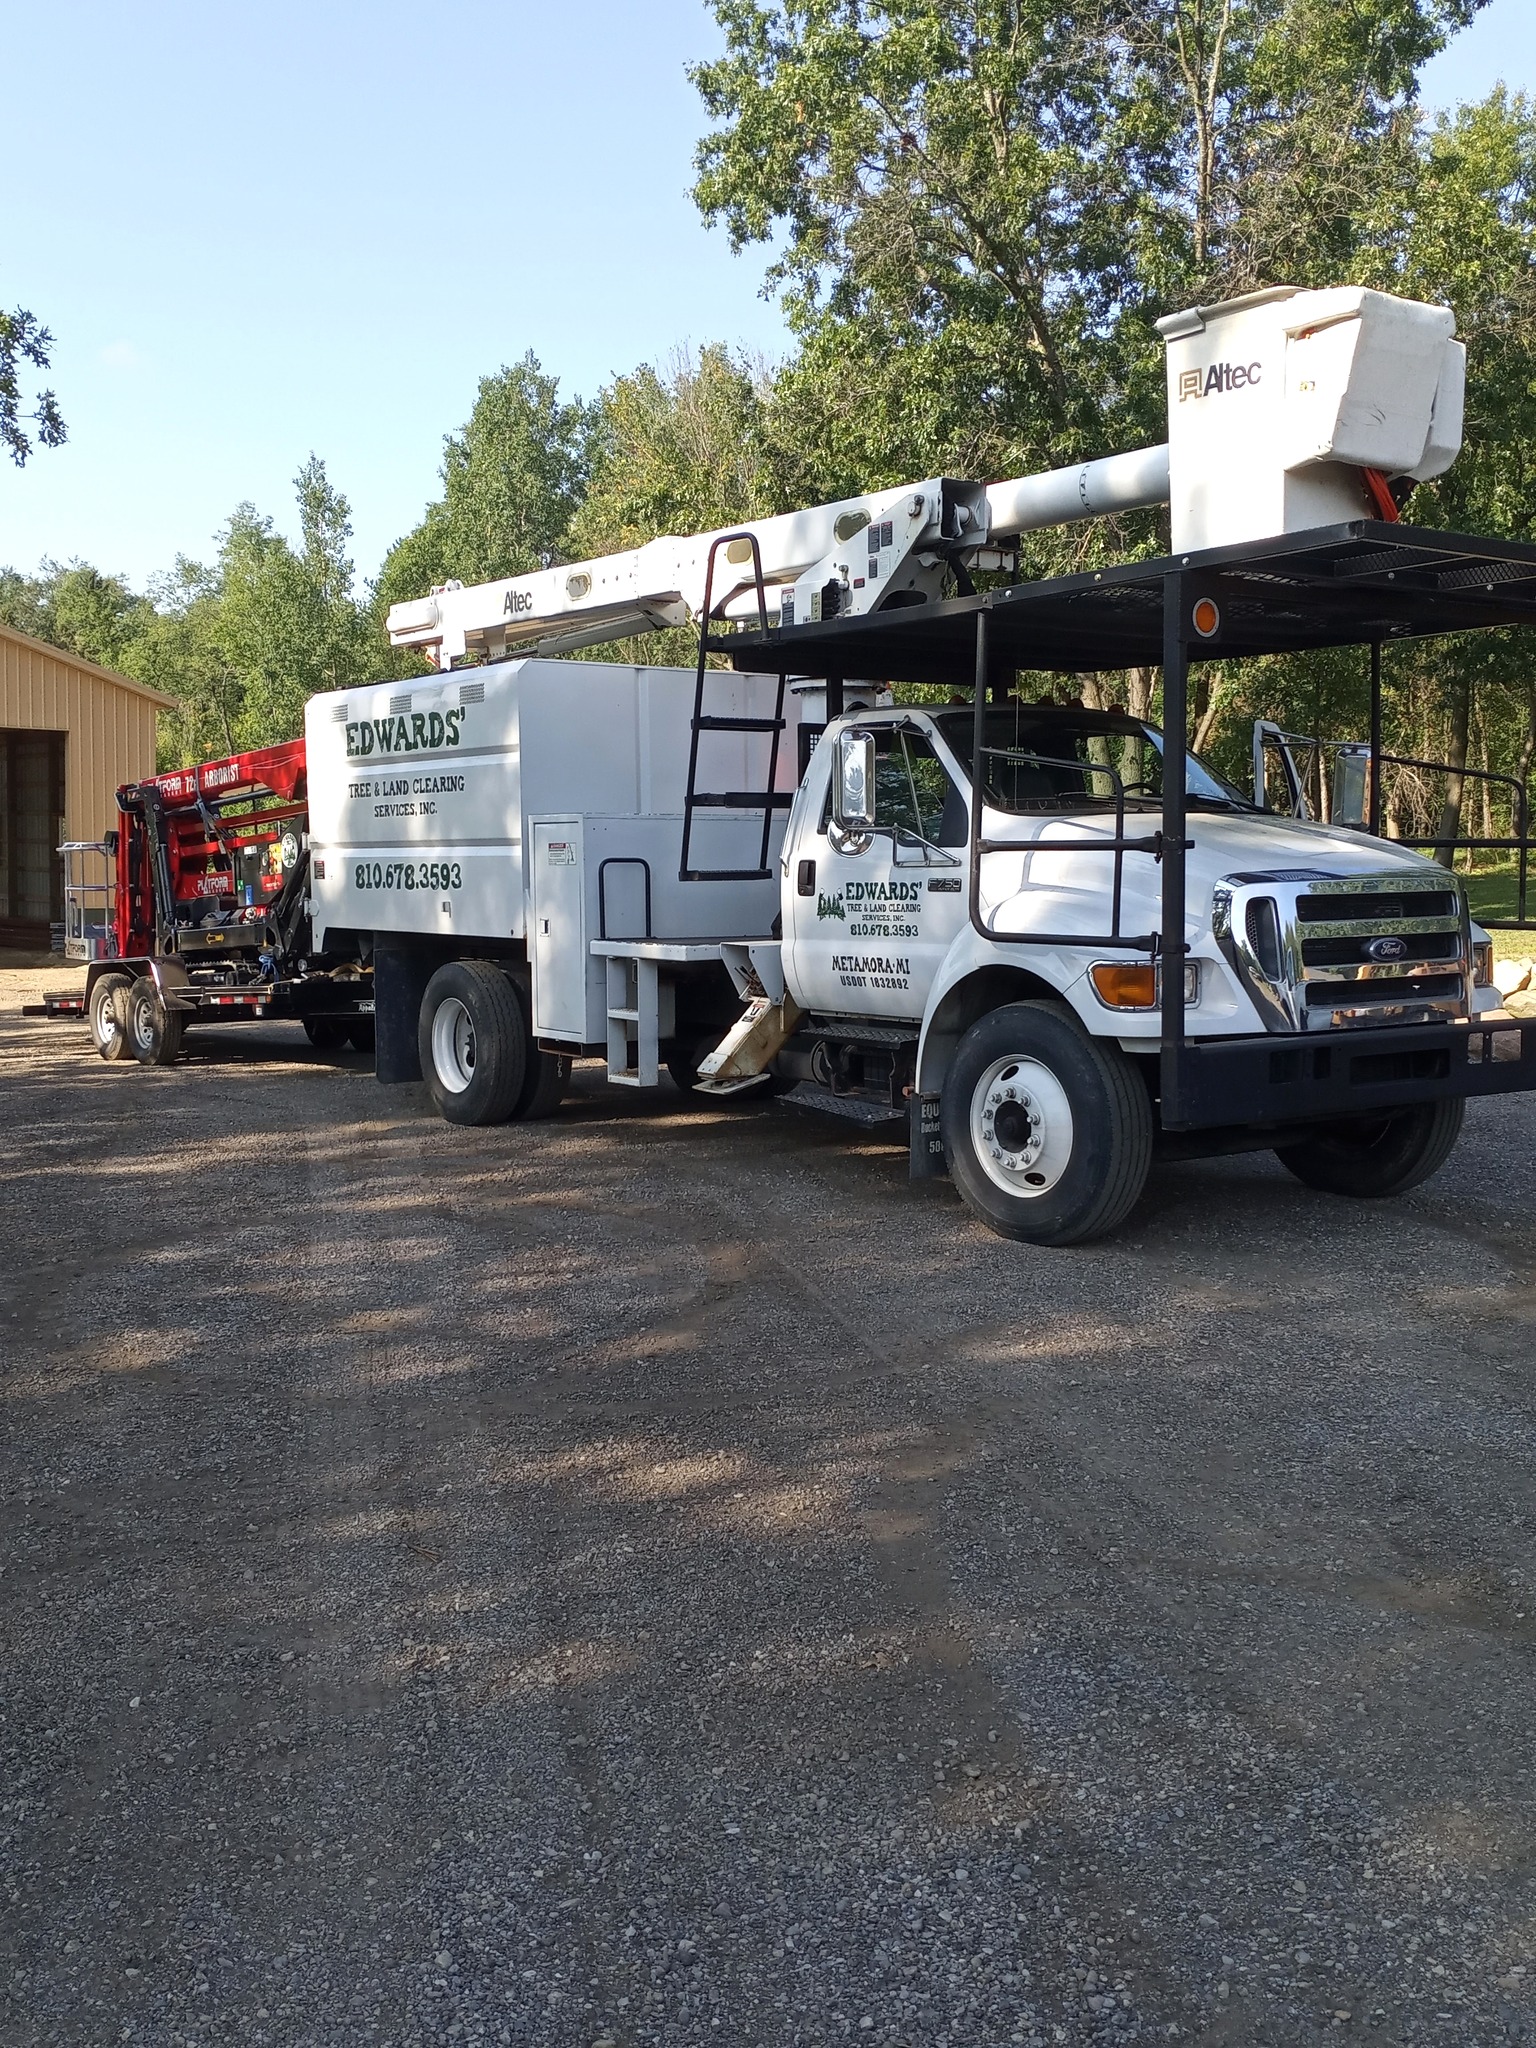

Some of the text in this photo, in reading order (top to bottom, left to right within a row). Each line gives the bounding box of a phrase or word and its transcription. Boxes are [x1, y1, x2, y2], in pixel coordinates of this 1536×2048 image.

[1203, 362, 1262, 397] Altec
[503, 590, 533, 615] Altec
[345, 706, 465, 756] EDWARDS'
[204, 764, 239, 789] ARBORIST
[348, 775, 465, 799] TREE & LAND CLEARING
[374, 801, 438, 818] SERVICES, INC.
[355, 862, 462, 890] 810.678.3593
[845, 881, 922, 901] EDWARDS'
[847, 903, 922, 913] TREE & LAND CLEARING
[892, 914, 905, 922] INC.
[850, 923, 919, 937] 810.678.3593
[1380, 941, 1401, 955] Ford
[840, 975, 909, 990] USDOT 1832892
[921, 1103, 940, 1119] EQU
